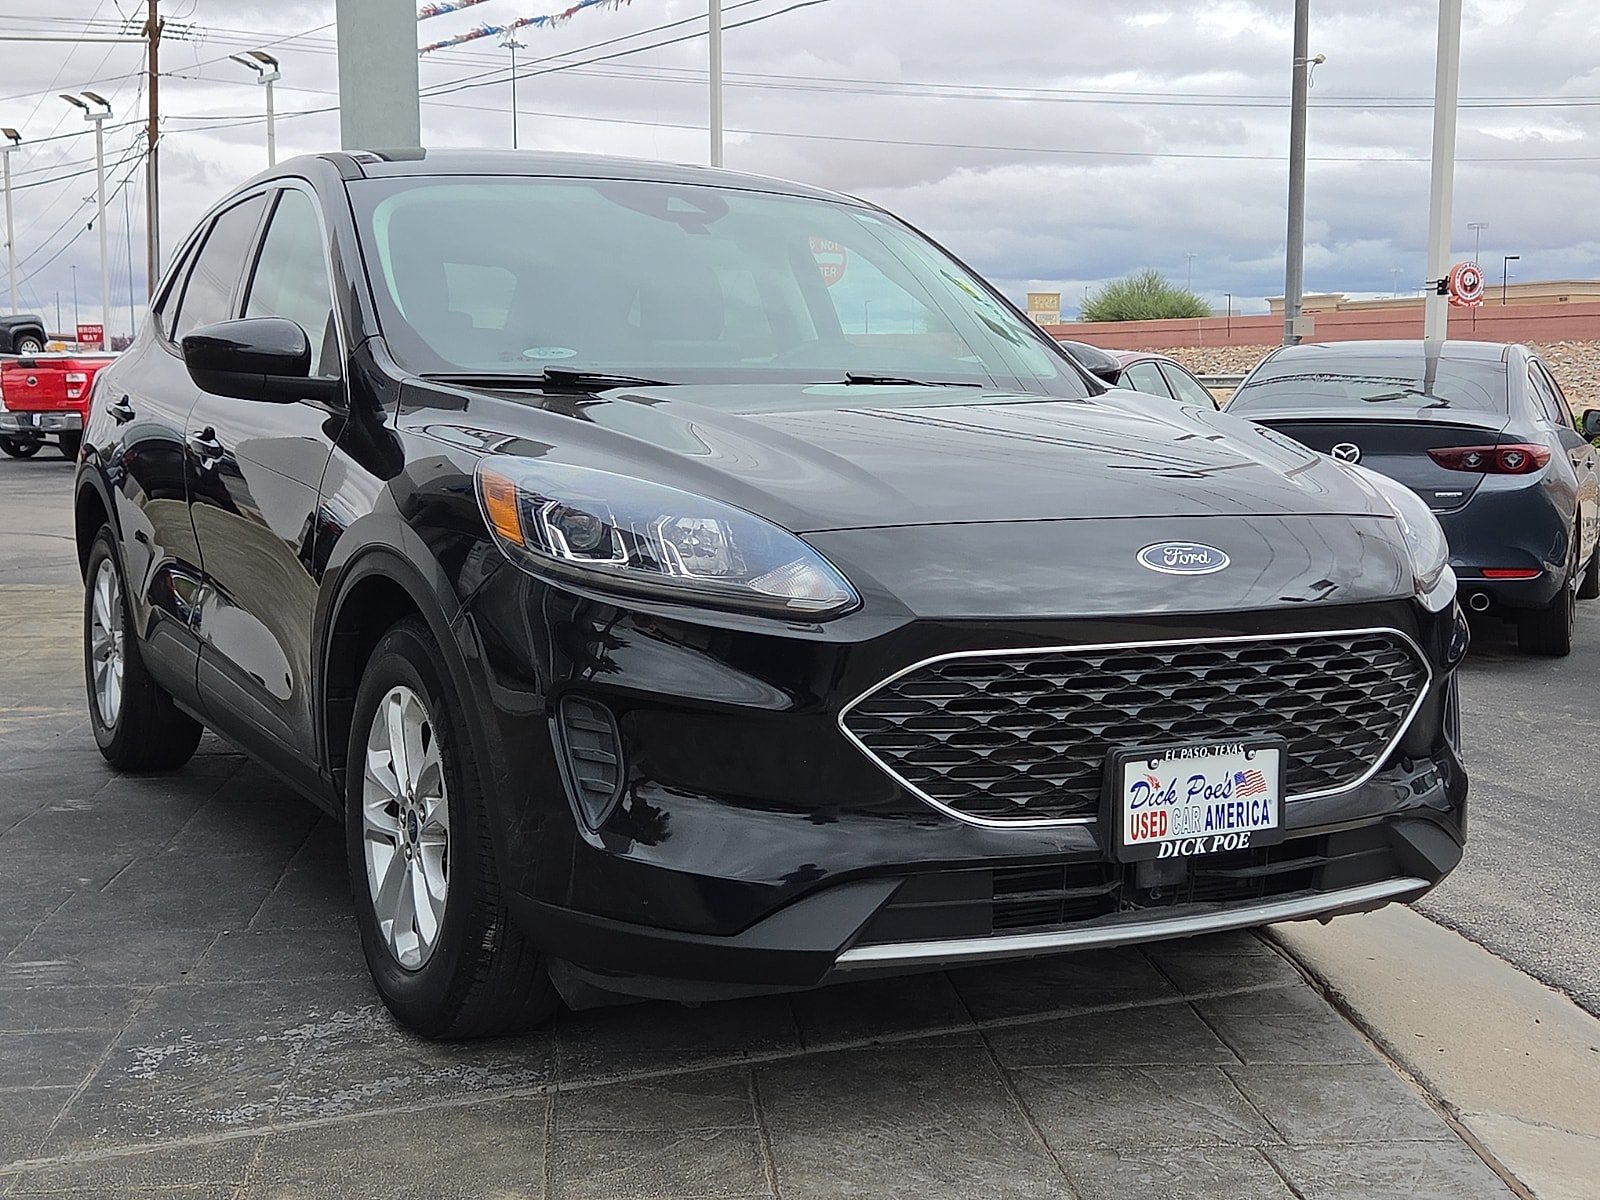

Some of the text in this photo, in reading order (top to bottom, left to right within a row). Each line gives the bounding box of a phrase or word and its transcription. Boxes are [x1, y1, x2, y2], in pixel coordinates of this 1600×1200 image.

[819, 266, 837, 277] TER
[78, 326, 102, 334] WRONG
[1163, 547, 1211, 566] Ford
[1165, 750, 1176, 760] EL
[1214, 744, 1245, 757] TEXAS
[1130, 770, 1234, 809] Dick Poe's
[1130, 799, 1270, 840] USED CAR AMERICA
[1156, 832, 1251, 859] DICK POE
